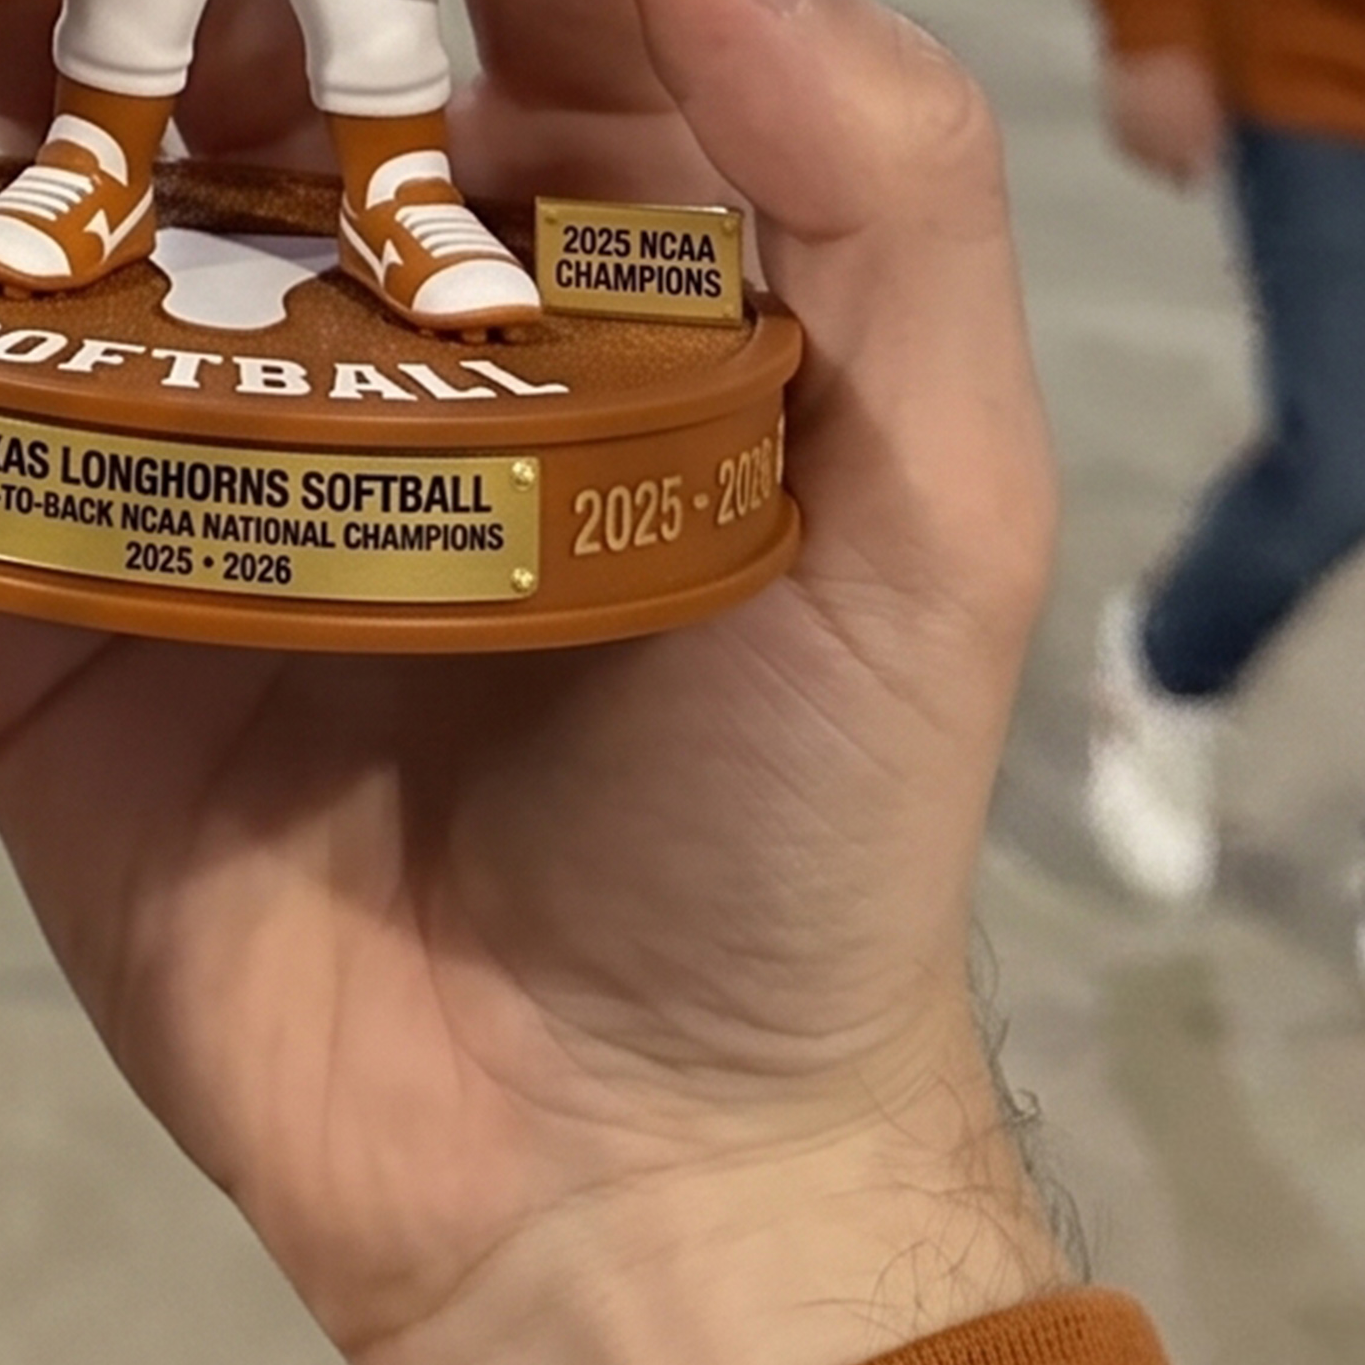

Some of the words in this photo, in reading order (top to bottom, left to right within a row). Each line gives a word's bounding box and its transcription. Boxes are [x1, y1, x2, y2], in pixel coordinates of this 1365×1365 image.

[562, 225, 632, 258] 2025
[639, 230, 716, 264] NCAA
[555, 259, 723, 298] CHAMPIONS
[60, 447, 289, 509] LONGHORNS
[301, 468, 493, 515] SOFTBALL
[120, 505, 195, 537] NCAA
[202, 511, 336, 549] NATIONAL
[343, 521, 505, 553] CHAMPIONS
[574, 475, 683, 556] 2025
[125, 540, 193, 575] 2025
[223, 550, 292, 586] 2026
